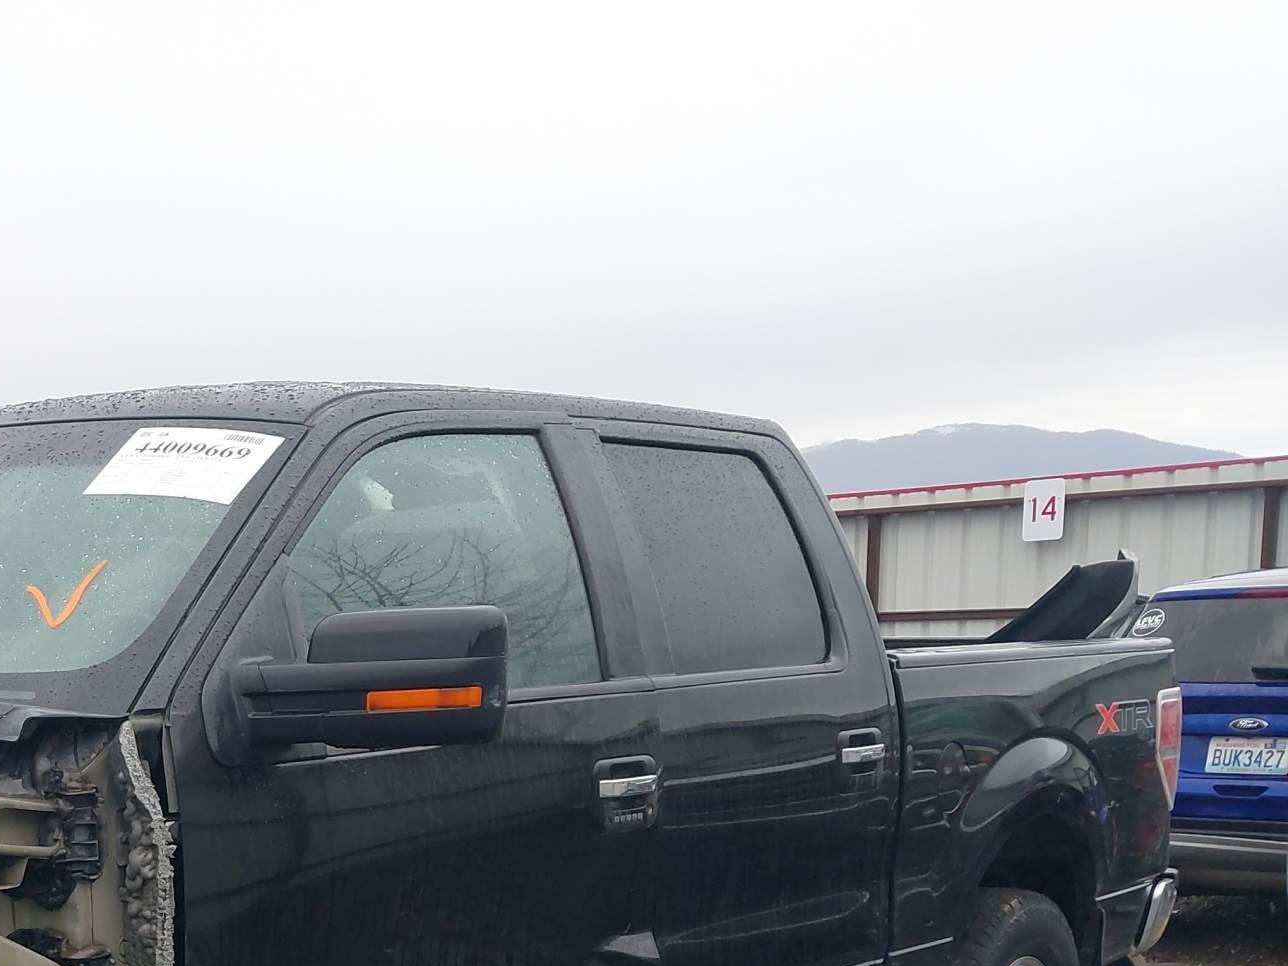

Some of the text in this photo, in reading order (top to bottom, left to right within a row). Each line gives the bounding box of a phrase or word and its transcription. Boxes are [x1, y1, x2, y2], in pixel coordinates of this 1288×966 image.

[134, 441, 252, 460] 44009669
[1031, 495, 1057, 523] 14
[1095, 699, 1154, 735] XTR
[1211, 748, 1286, 769] BUK3427
